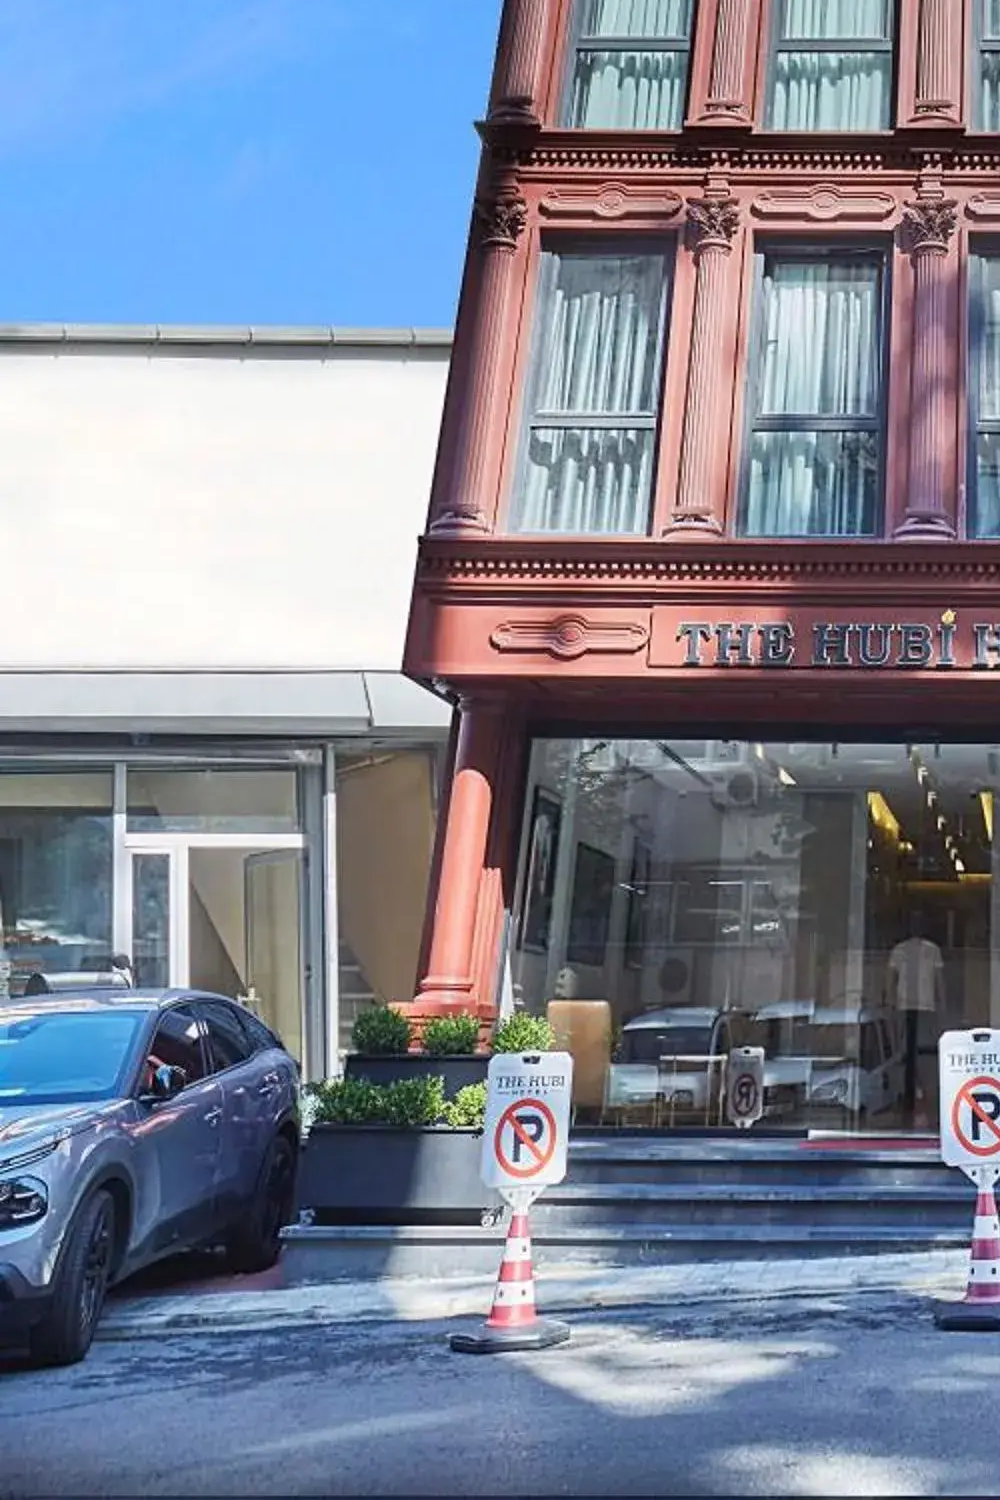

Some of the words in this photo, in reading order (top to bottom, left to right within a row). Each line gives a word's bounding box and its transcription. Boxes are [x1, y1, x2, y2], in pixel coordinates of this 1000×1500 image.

[677, 622, 795, 667] THE
[947, 1053, 978, 1066] THE
[496, 1075, 527, 1088] THE
